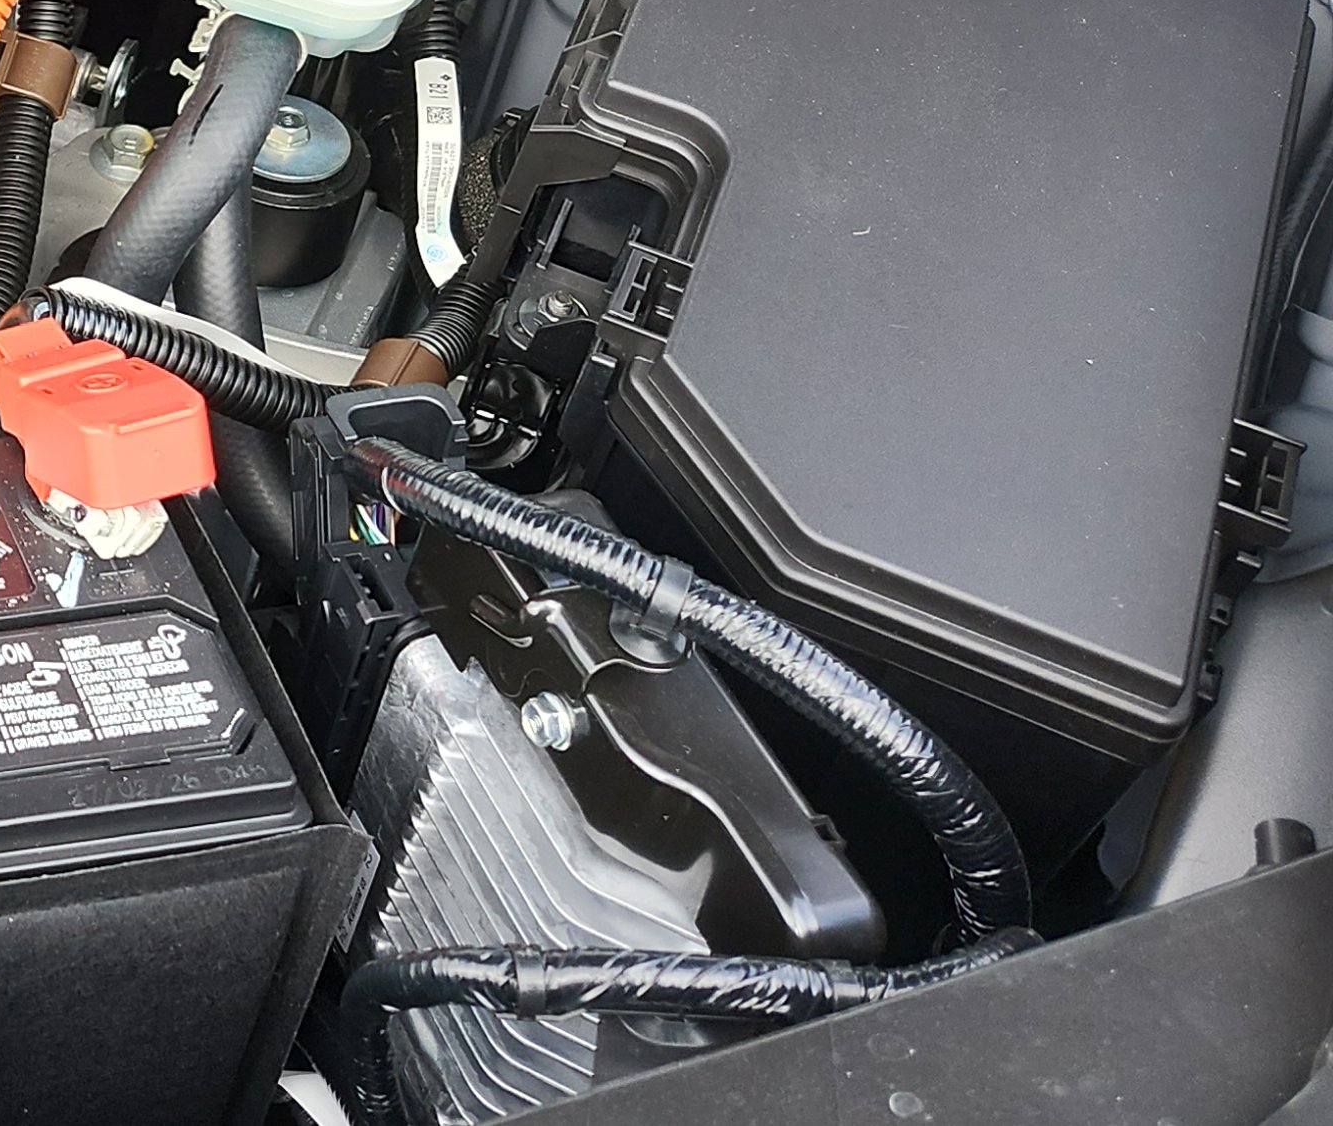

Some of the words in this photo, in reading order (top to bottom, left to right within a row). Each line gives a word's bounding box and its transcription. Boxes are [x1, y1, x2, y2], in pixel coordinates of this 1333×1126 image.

[73, 660, 93, 674] LES
[91, 657, 116, 671] YEUX
[77, 667, 132, 685] CONSULTER
[82, 682, 111, 696] SANS
[4, 711, 27, 725] PEUT
[9, 726, 23, 737] LA
[49, 719, 64, 731] OU
[62, 717, 78, 730] DE
[14, 735, 49, 751] GRAVES
